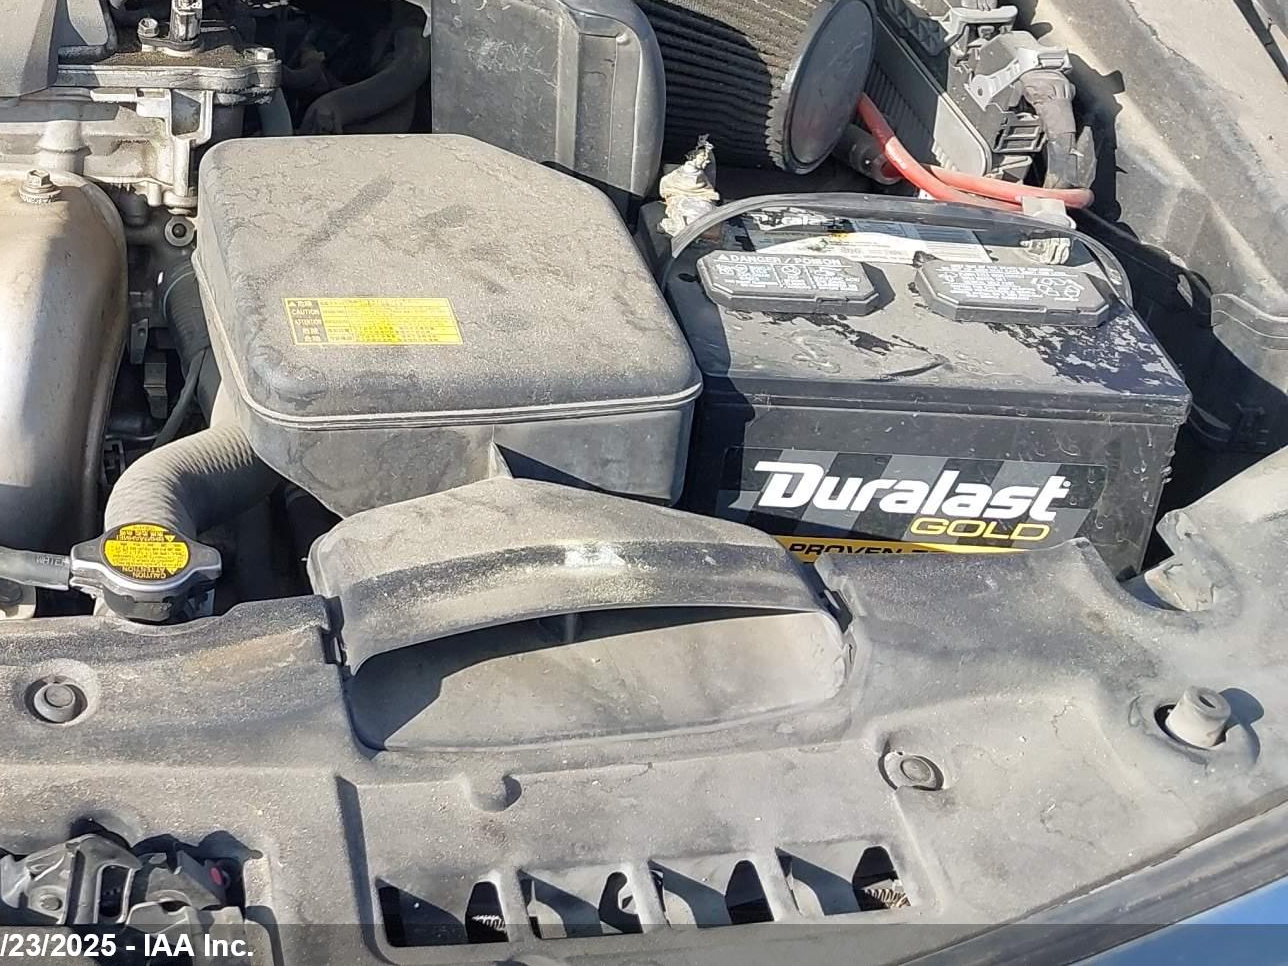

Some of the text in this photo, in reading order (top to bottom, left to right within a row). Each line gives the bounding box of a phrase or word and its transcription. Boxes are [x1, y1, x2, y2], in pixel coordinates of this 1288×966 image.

[730, 254, 781, 265] DANGER
[794, 257, 842, 266] POISON
[754, 460, 1069, 522] Duralast
[910, 517, 1050, 541] GOLD
